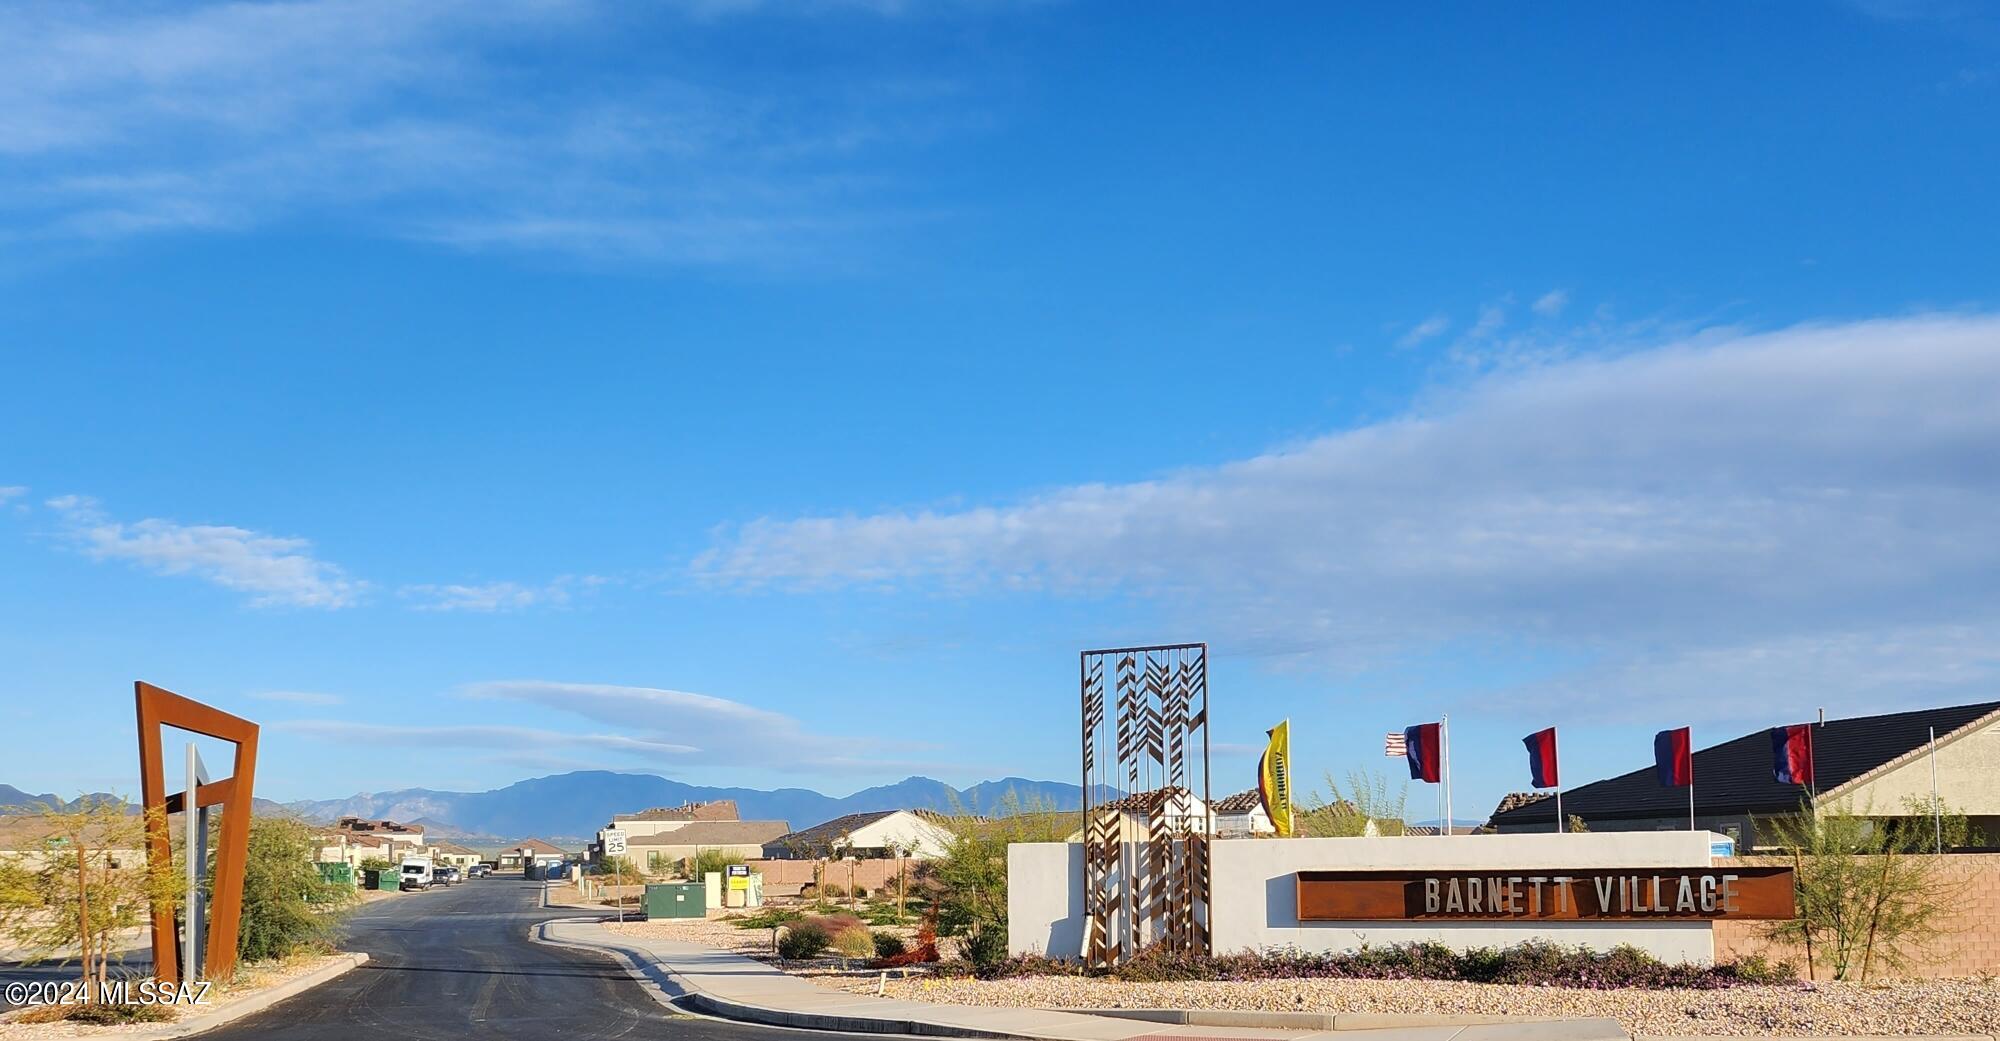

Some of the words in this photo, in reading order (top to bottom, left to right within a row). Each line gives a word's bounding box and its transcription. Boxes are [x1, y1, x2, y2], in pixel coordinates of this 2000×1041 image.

[608, 843, 624, 852] 25
[1425, 877, 1573, 913] BARNETT
[1594, 875, 1739, 912] VILLAGE
